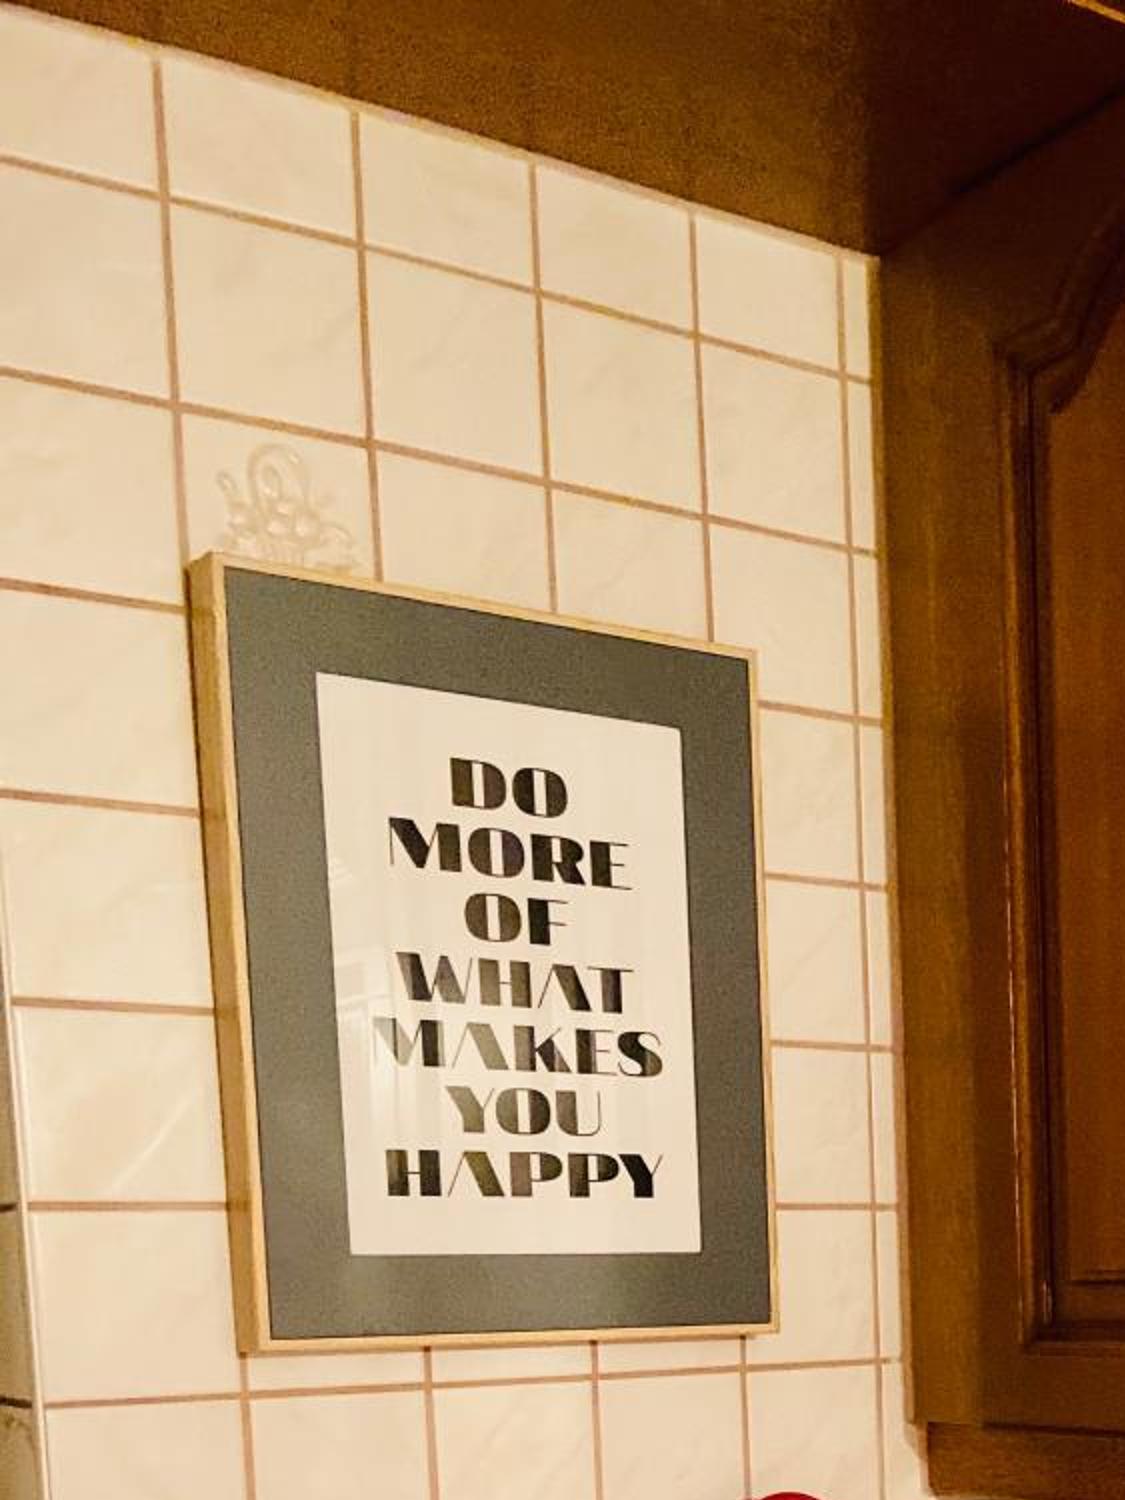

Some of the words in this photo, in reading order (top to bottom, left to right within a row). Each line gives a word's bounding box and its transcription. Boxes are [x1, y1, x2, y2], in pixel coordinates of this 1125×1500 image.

[450, 757, 568, 818] DO
[388, 817, 632, 890] MORE
[464, 893, 569, 945] OF
[396, 951, 634, 1014] WHAT
[373, 1017, 663, 1077] MAKES
[445, 1085, 602, 1136] YOU
[385, 1149, 663, 1198] HAPPY
